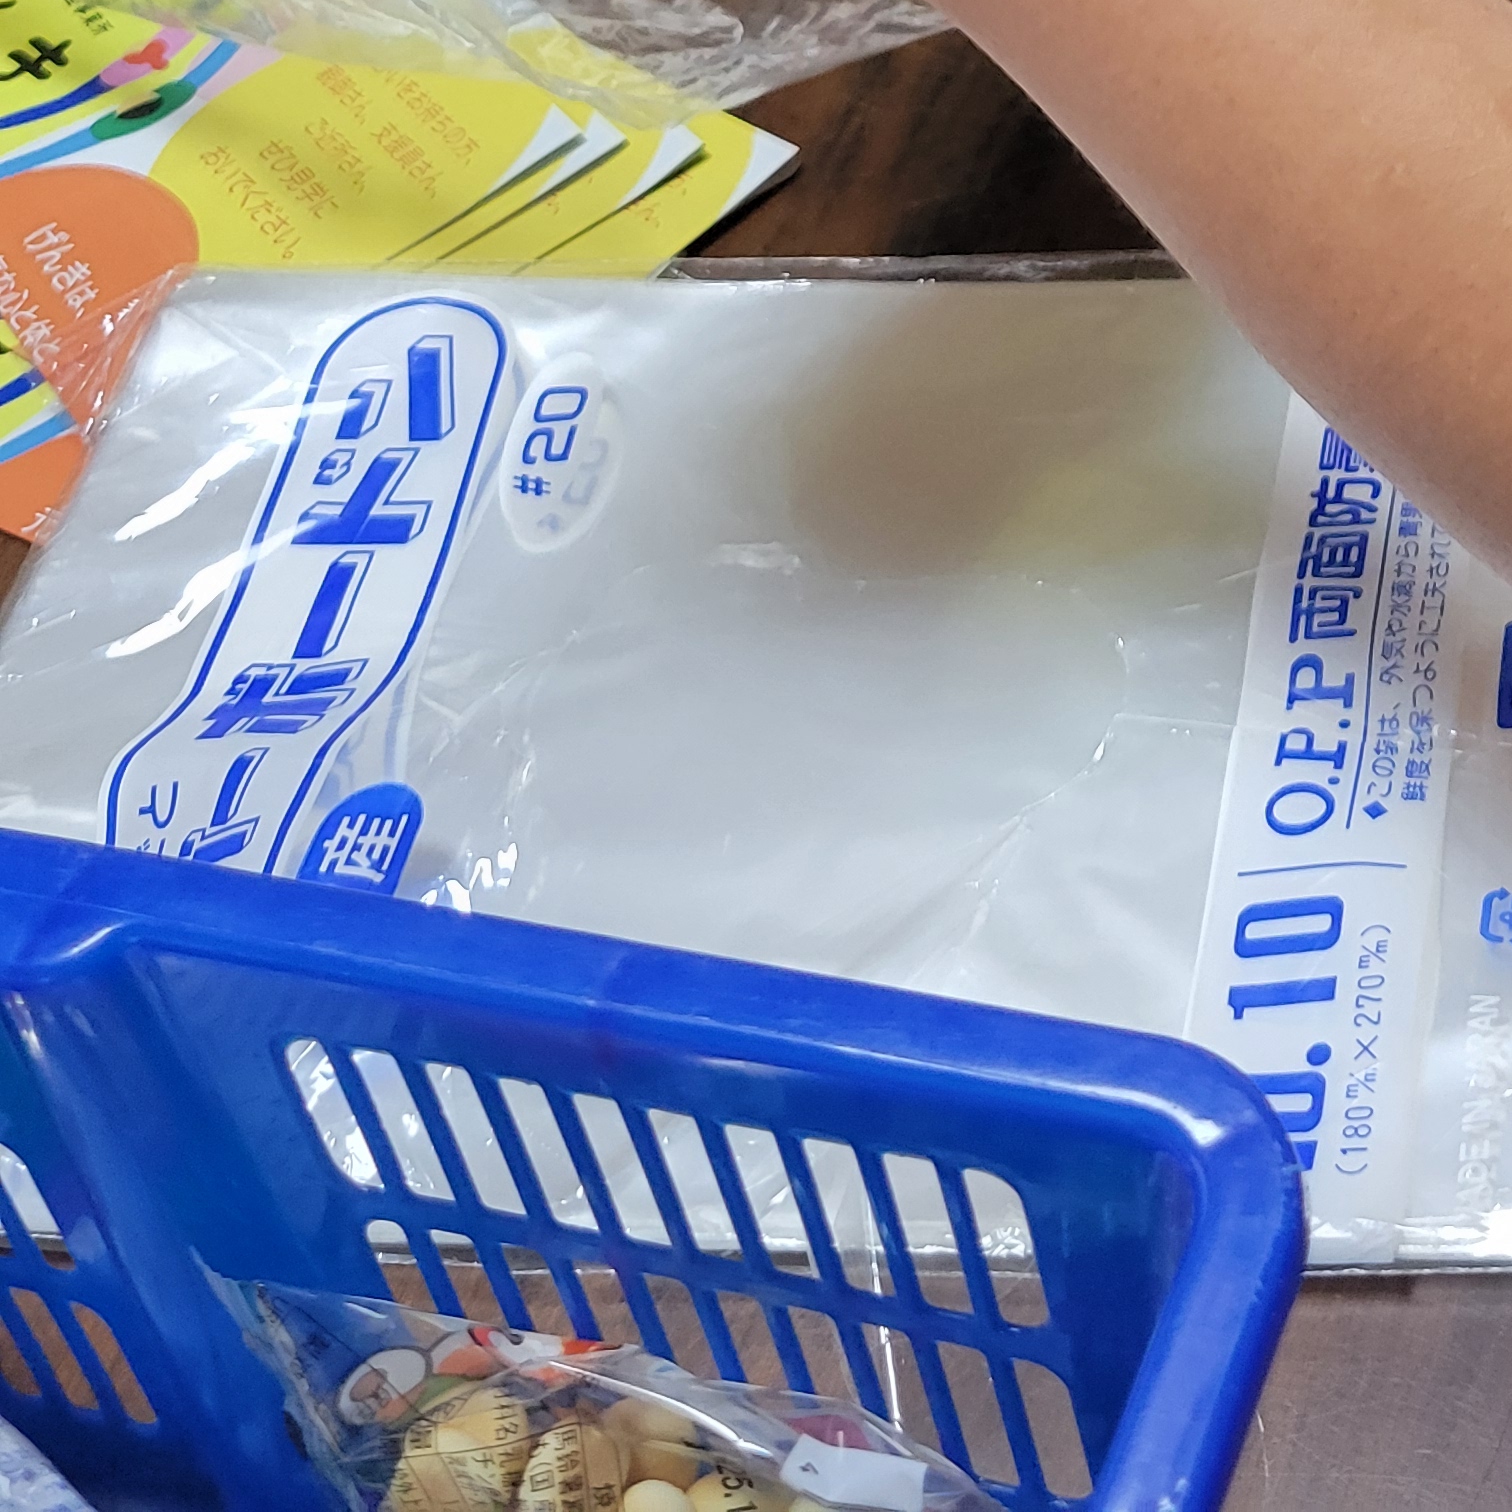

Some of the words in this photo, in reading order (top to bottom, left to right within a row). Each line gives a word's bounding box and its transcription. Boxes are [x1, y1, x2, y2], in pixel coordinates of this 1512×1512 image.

[23, 222, 100, 318] げんきは、
[513, 384, 590, 497] #20
